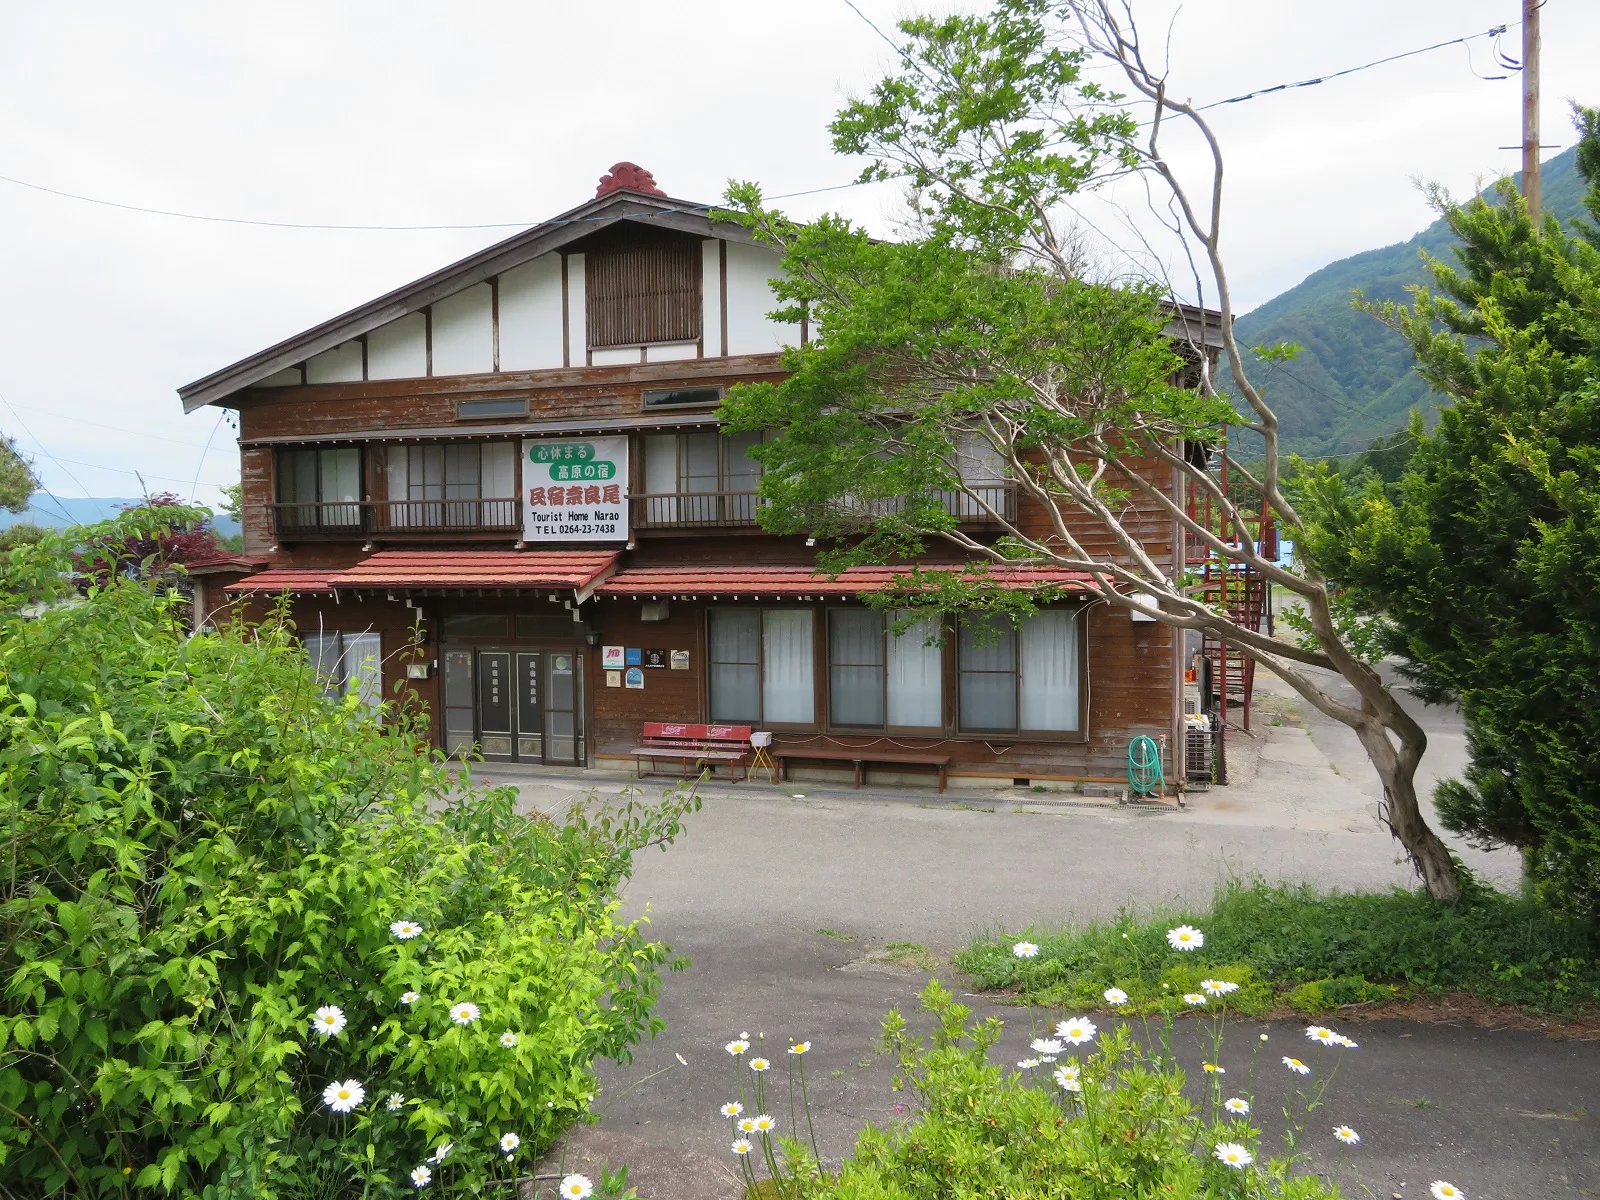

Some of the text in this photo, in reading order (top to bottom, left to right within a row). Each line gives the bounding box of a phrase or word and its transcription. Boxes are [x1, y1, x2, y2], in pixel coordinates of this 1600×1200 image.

[538, 445, 586, 460] 心休まる
[558, 464, 608, 479] 高原の宿
[532, 511, 619, 522] Tourist Home Narao
[536, 524, 615, 535] TEL 0264-23-7438
[606, 648, 621, 659] JTB
